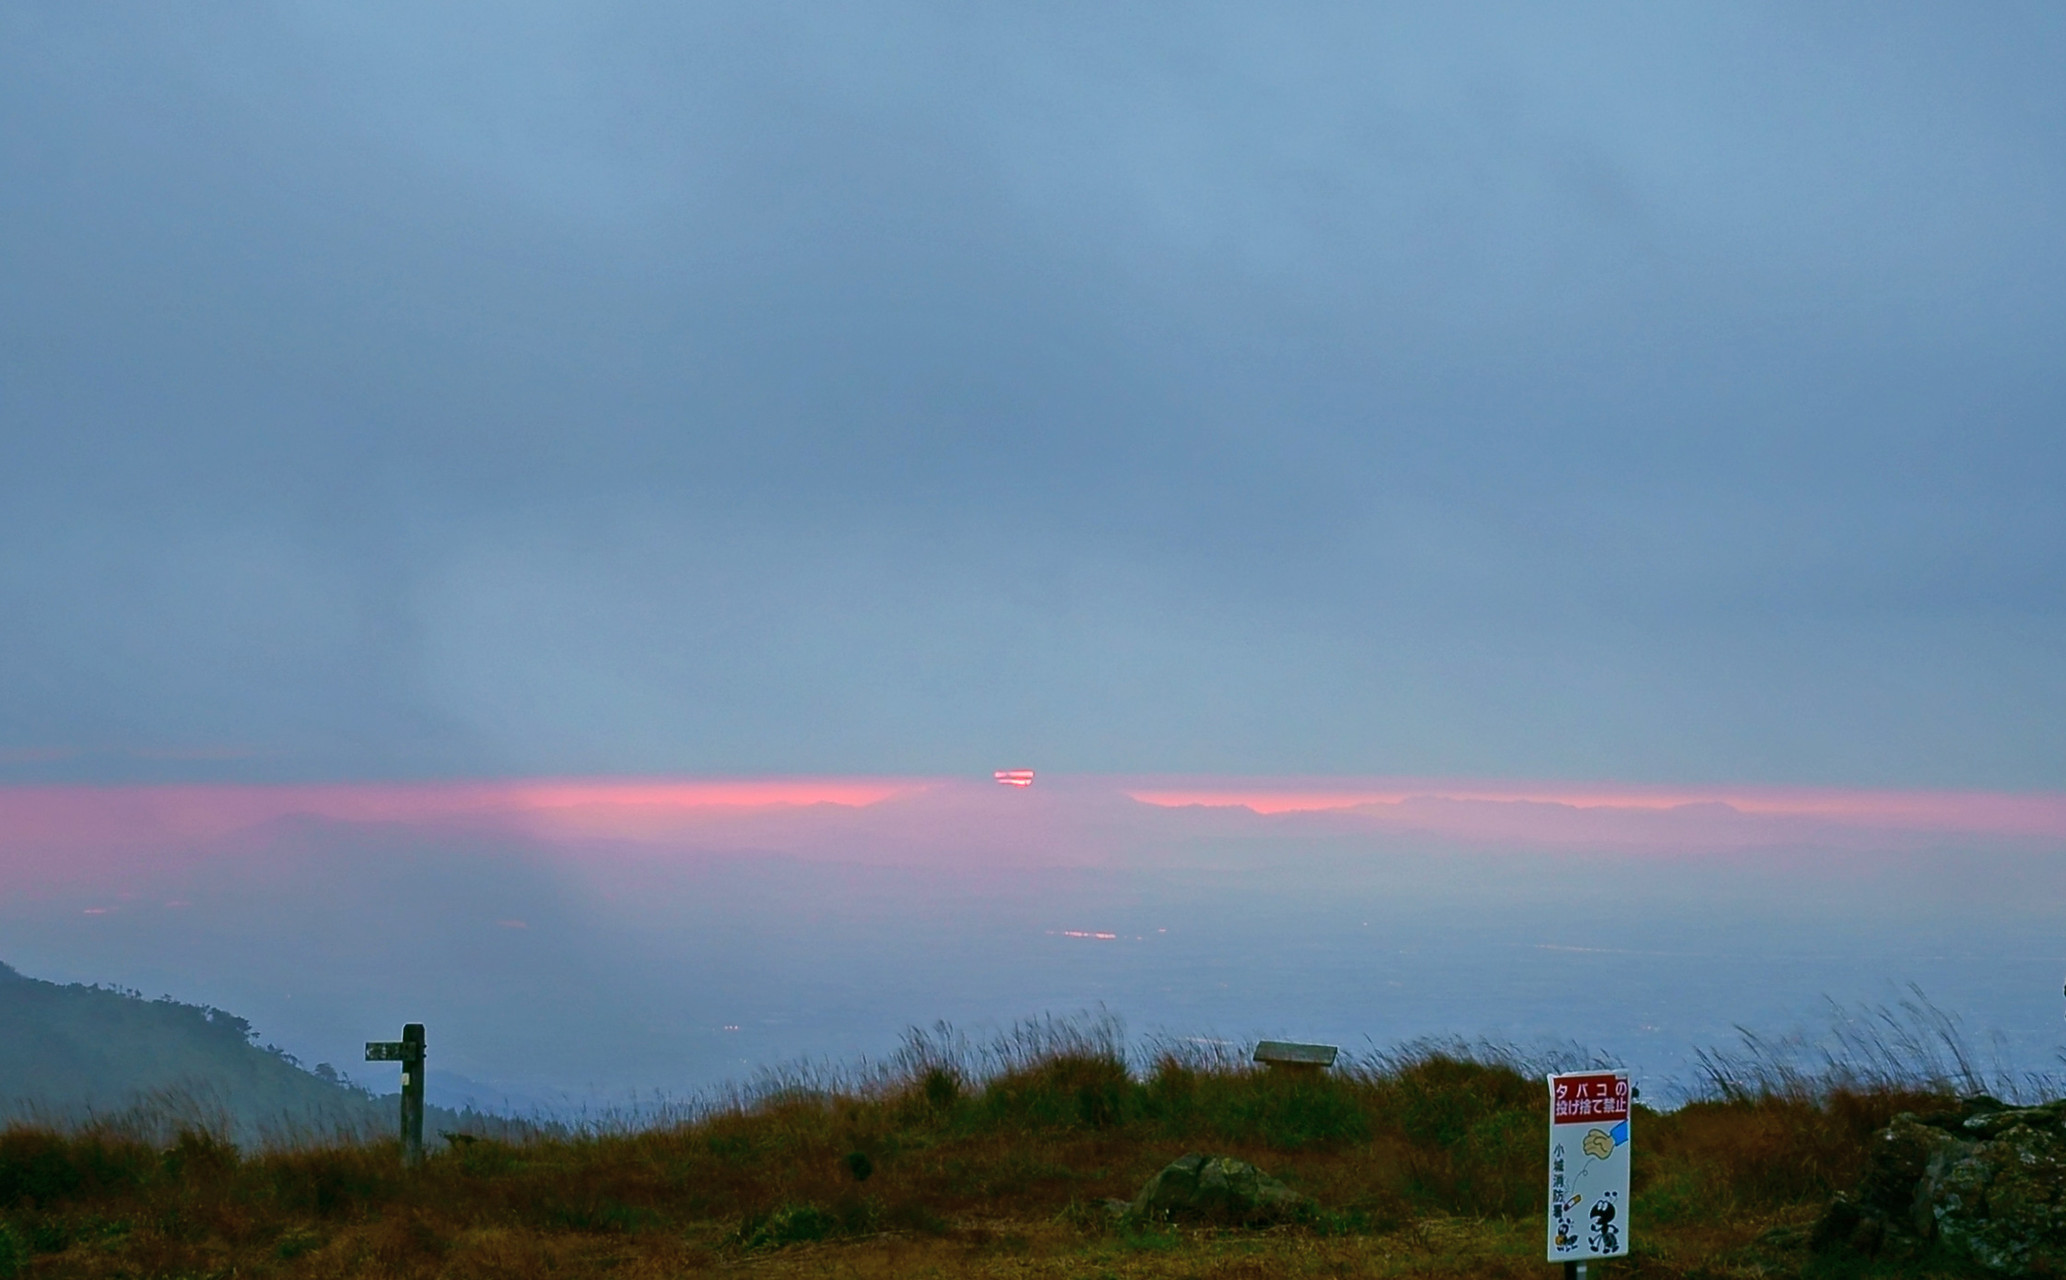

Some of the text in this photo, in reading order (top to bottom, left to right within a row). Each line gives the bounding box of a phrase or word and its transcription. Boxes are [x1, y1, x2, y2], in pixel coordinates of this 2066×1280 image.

[1556, 1081, 1627, 1099] タバコの
[1556, 1097, 1627, 1116] 投げ捨て禁止
[1553, 1143, 1565, 1218] 小城消防署
